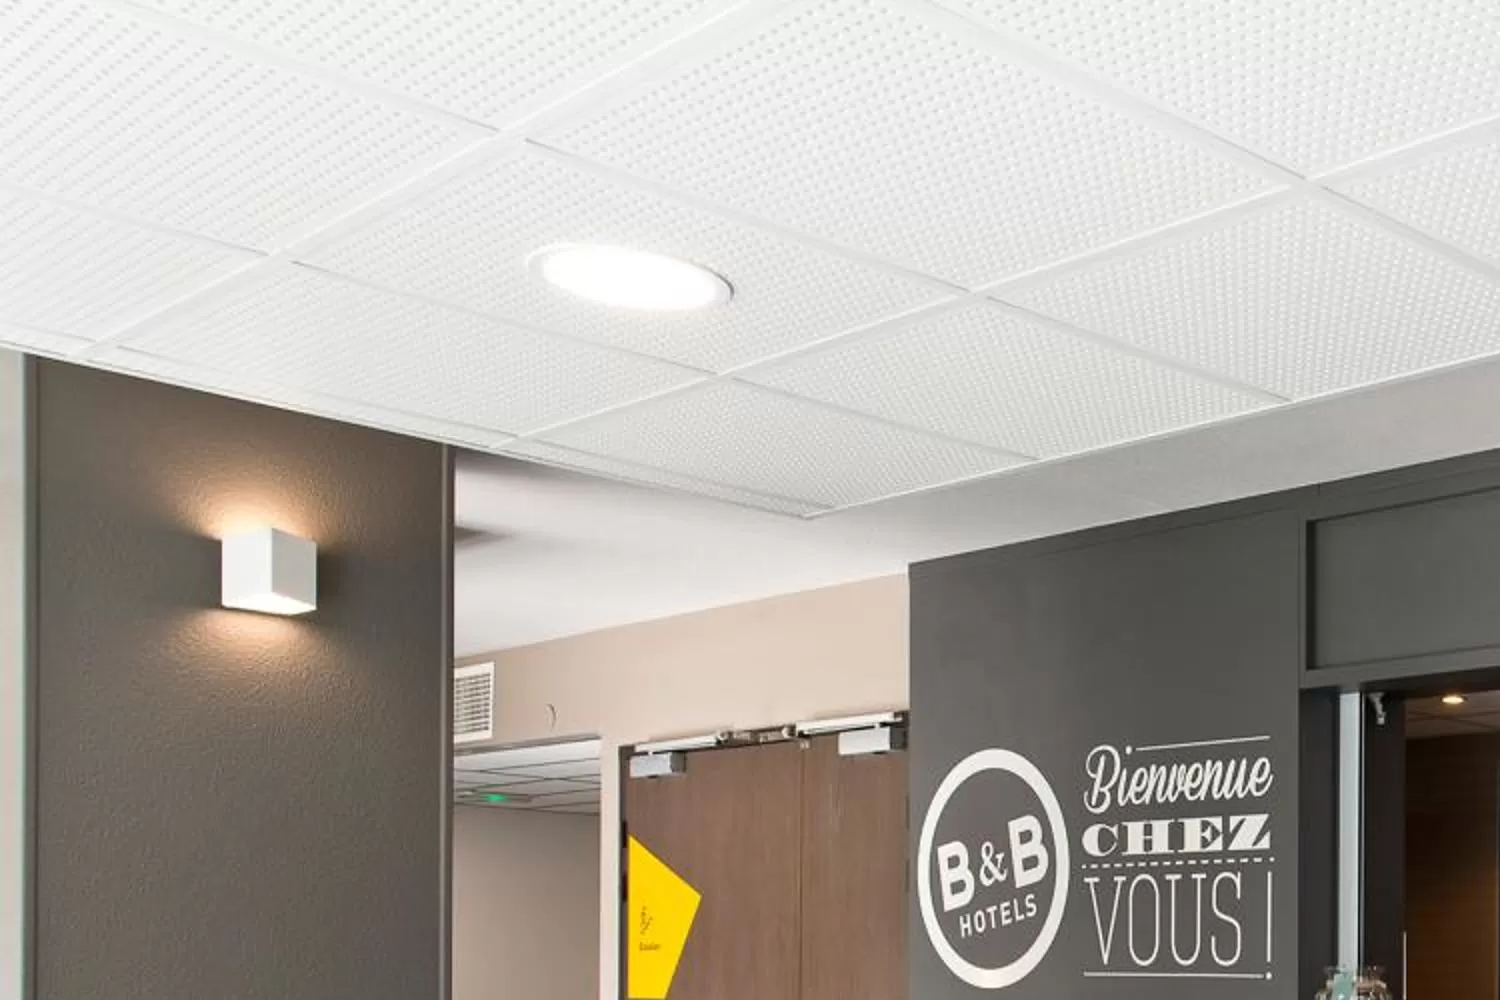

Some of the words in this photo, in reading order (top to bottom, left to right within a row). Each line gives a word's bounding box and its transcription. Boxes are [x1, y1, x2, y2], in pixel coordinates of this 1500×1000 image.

[1083, 744, 1274, 815] Bienvenue
[937, 814, 1049, 912] B&B
[1081, 813, 1272, 857] CHEZ
[959, 893, 1038, 938] HOTELS
